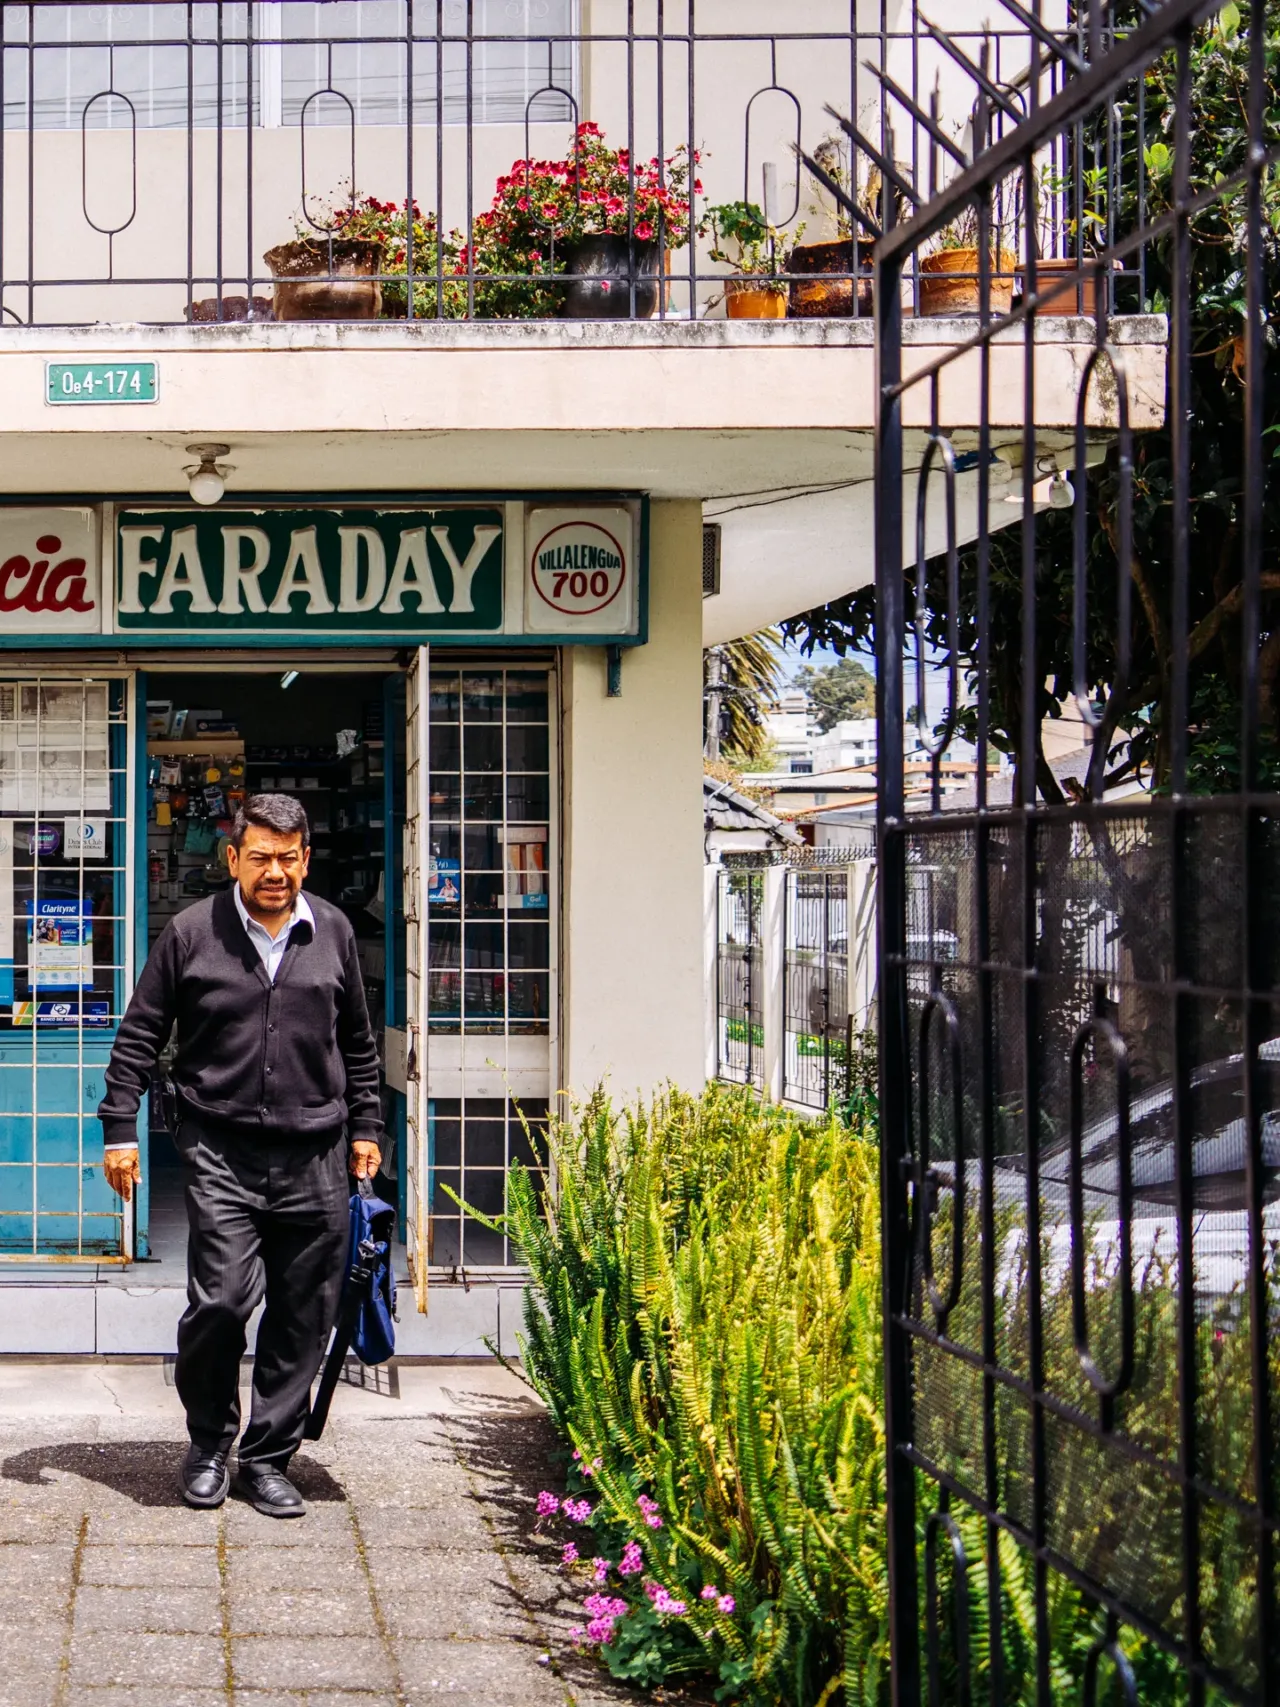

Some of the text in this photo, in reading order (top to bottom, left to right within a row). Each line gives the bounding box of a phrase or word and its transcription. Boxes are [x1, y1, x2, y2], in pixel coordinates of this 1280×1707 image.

[118, 524, 503, 615] FARADAY
[538, 541, 621, 570] VILLALENGUA
[552, 571, 609, 599] 700
[68, 837, 87, 845] Dines
[41, 904, 77, 914] Clarityne
